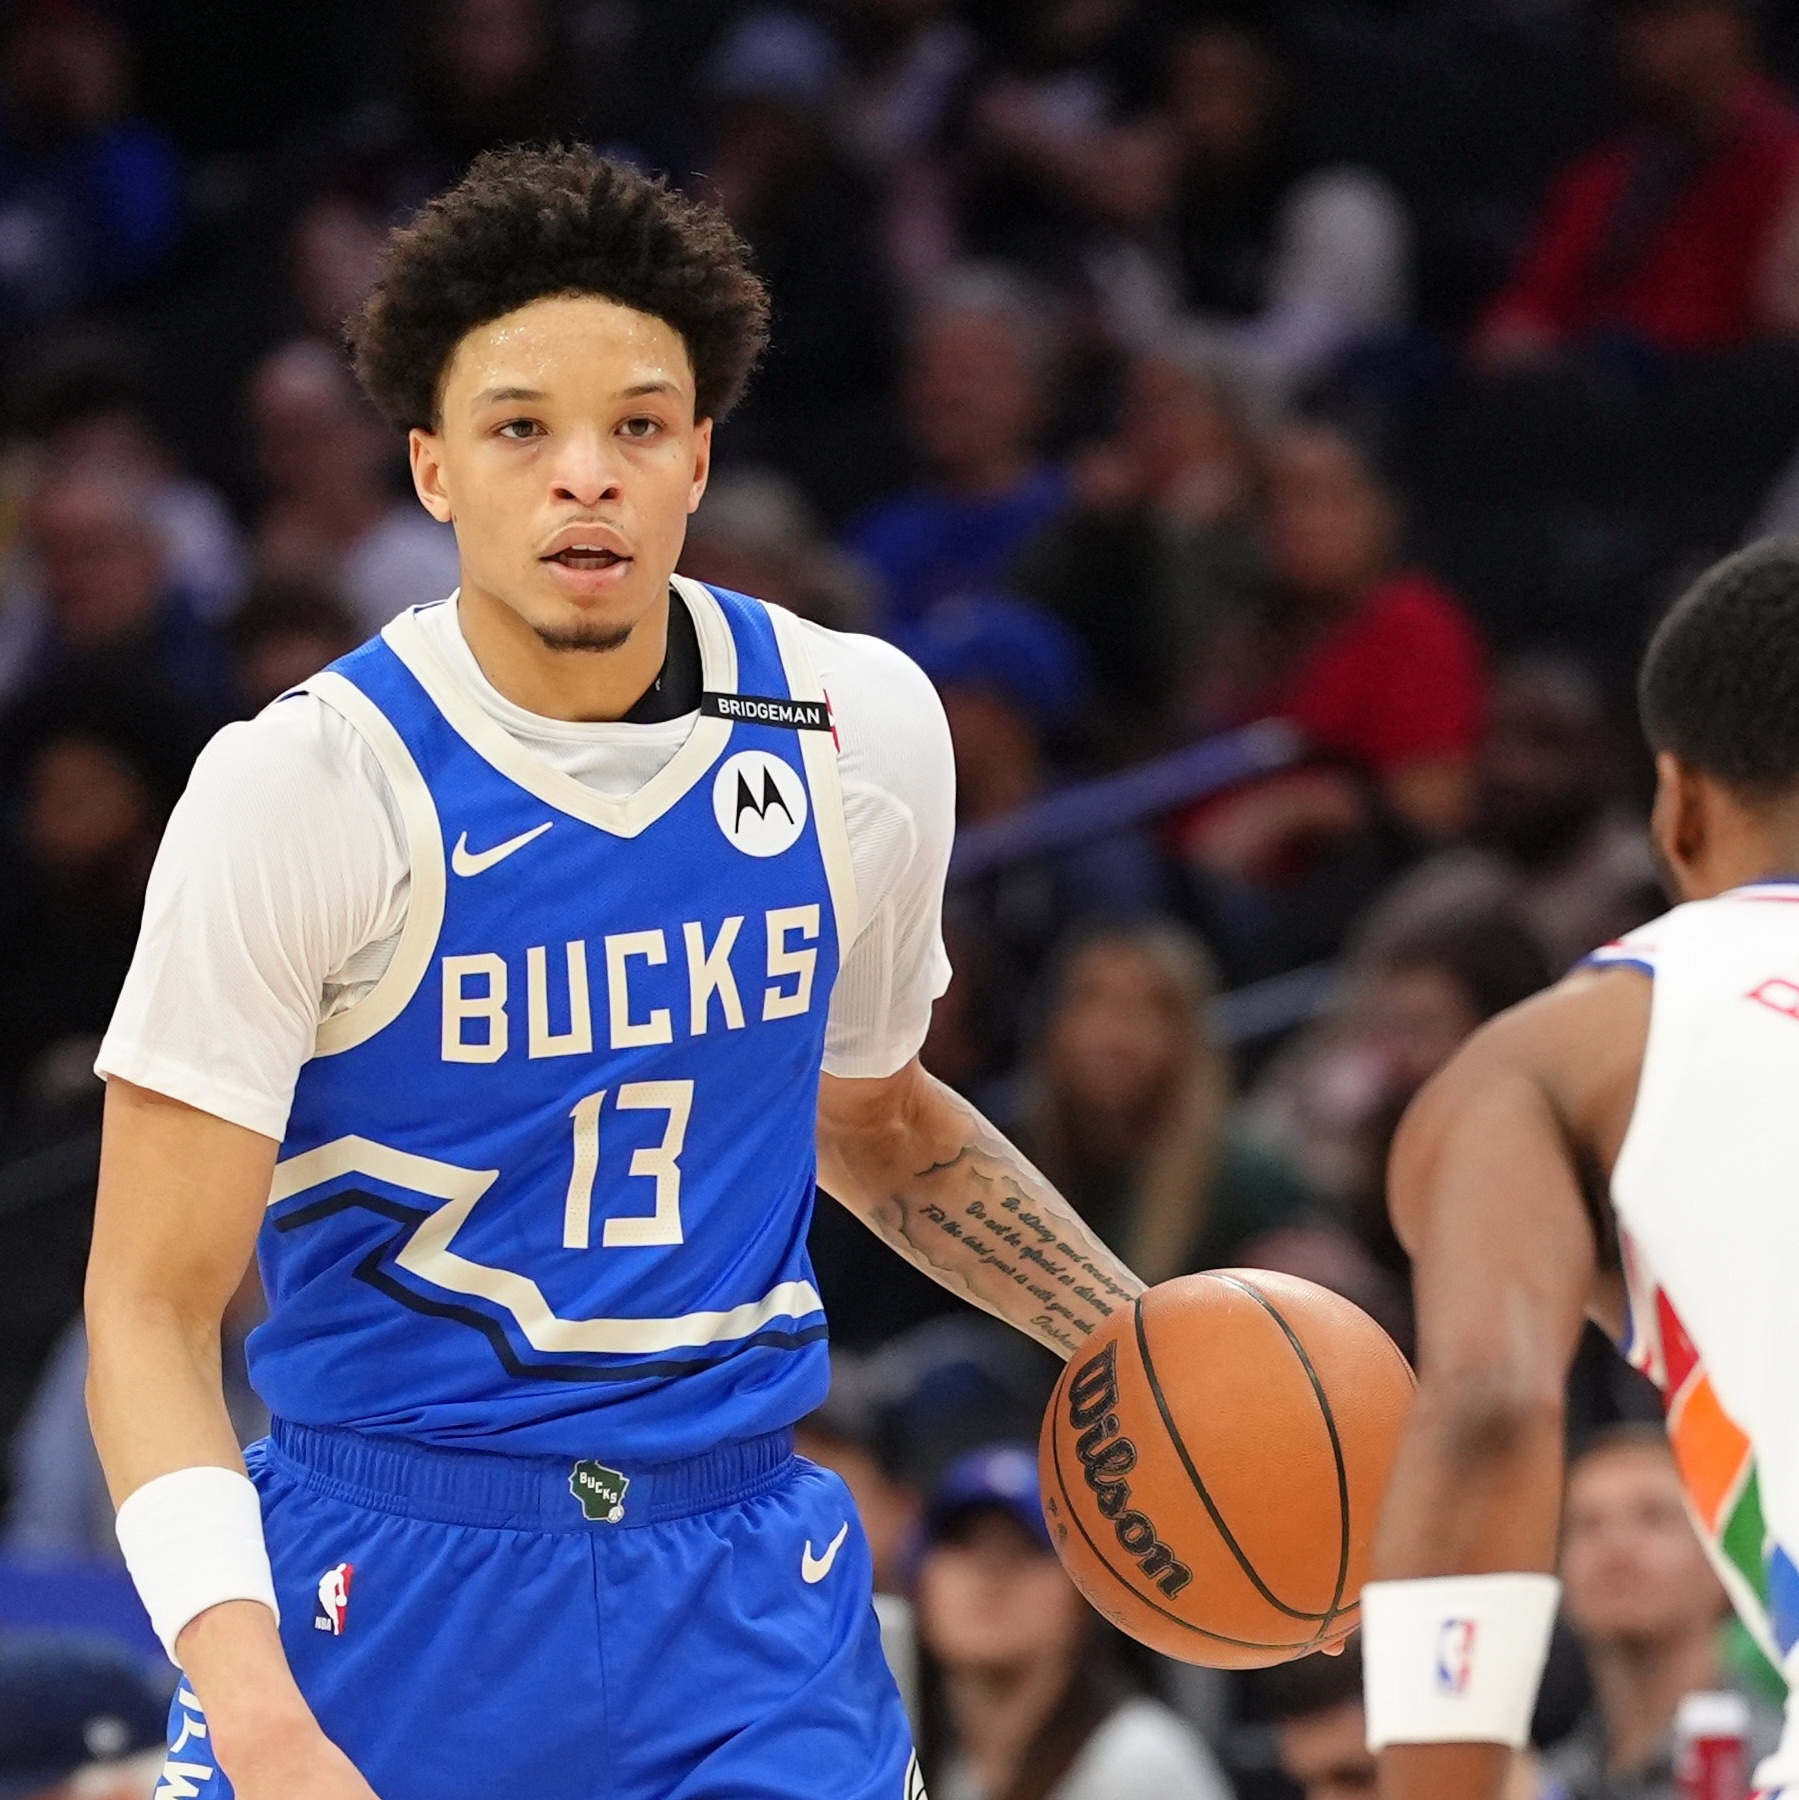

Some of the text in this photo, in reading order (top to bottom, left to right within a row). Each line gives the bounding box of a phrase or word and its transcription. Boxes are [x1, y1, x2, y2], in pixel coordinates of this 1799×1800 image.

[717, 698, 820, 725] BRIDGEMAN
[440, 903, 822, 1064] BUCKS
[561, 1079, 696, 1249] 13
[579, 1471, 617, 1503] BUCKS
[1068, 1339, 1193, 1600] Wilson
[314, 1616, 332, 1631] NBA
